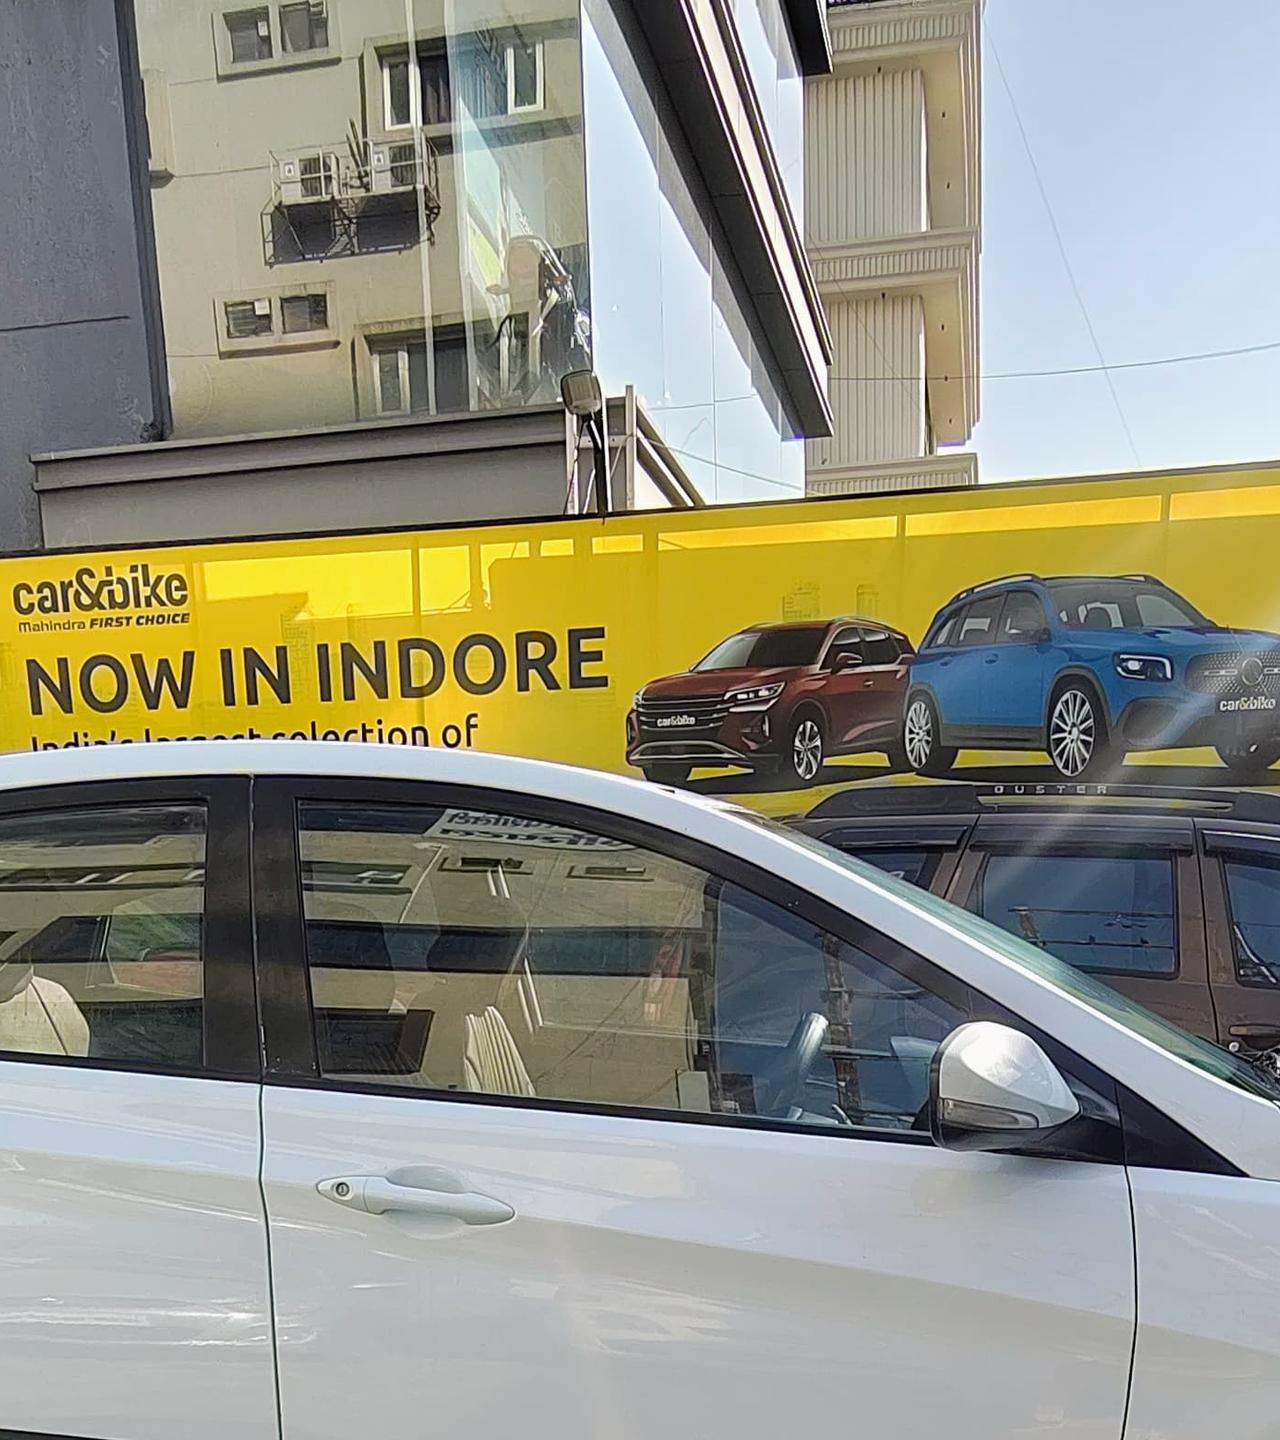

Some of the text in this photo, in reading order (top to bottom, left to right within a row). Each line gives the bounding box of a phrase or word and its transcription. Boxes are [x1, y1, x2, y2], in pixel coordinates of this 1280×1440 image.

[13, 564, 188, 616] car&bike
[18, 613, 190, 633] Mahindra FIRST CHOICE
[25, 626, 609, 716] NOW IN INDORE
[441, 713, 479, 749] of
